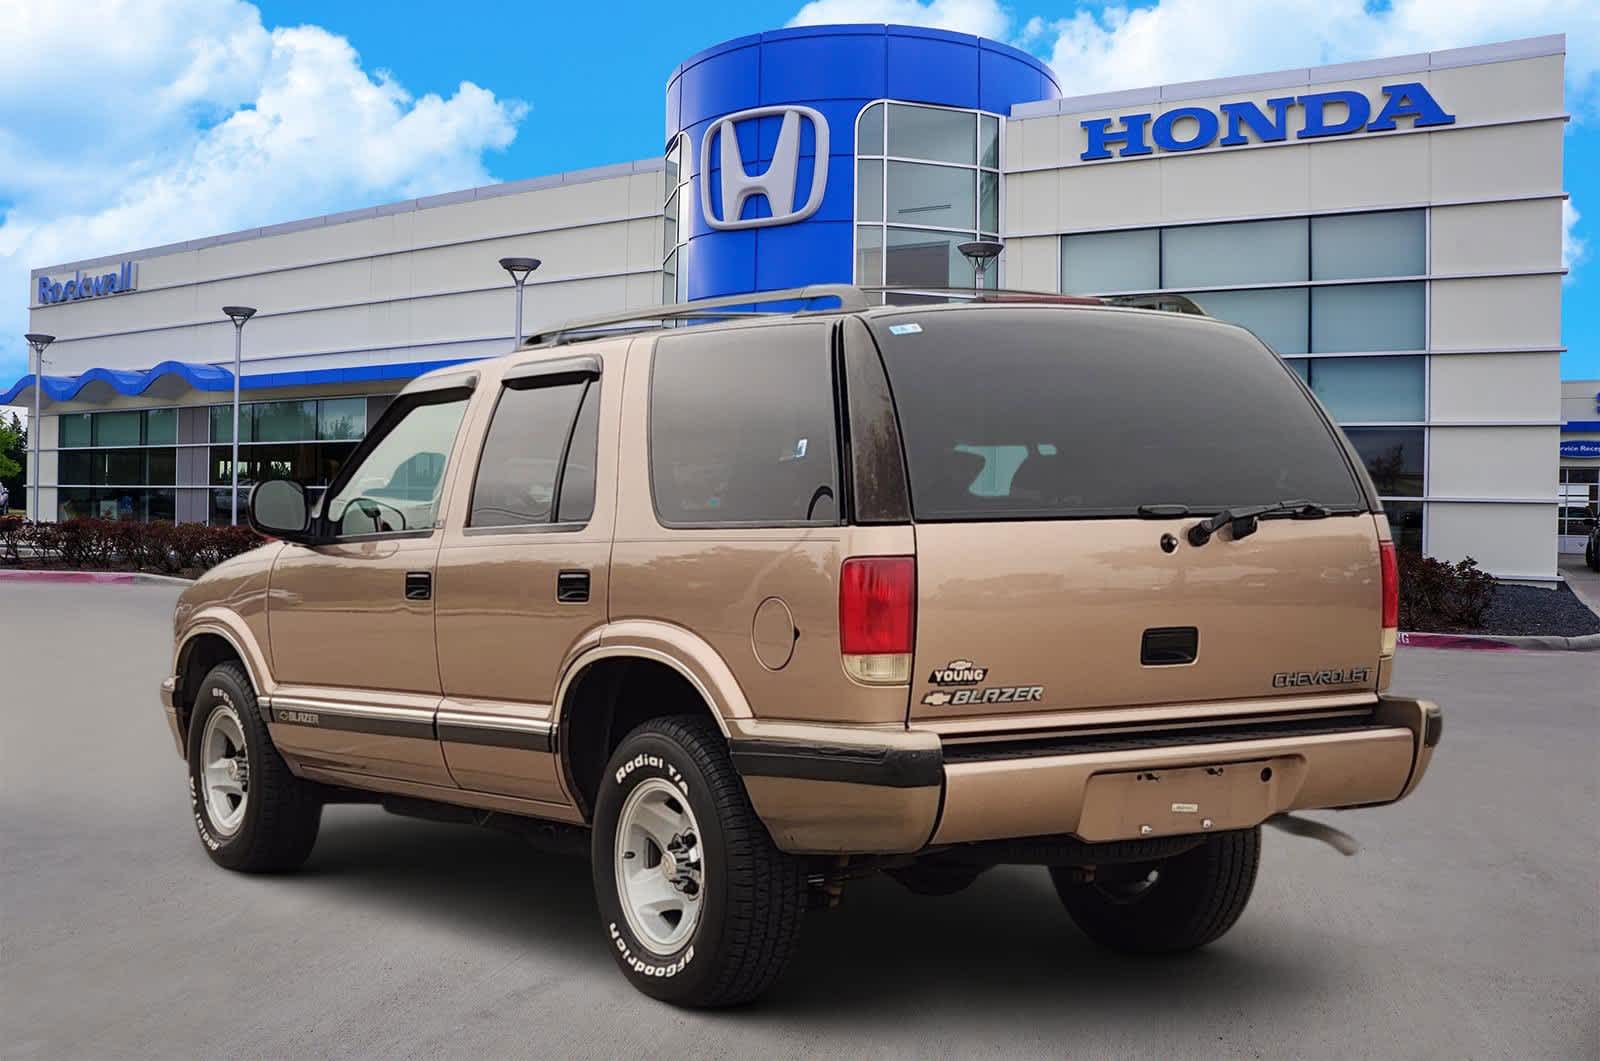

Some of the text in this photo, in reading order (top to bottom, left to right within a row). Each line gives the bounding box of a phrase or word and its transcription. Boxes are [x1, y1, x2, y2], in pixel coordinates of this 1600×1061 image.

[1080, 82, 1456, 161] HONDA
[38, 261, 132, 304] Rockwall
[935, 669, 984, 682] YOUNG
[1272, 666, 1373, 689] CHEVROLET
[950, 686, 1044, 705] BLAZER
[288, 711, 320, 724] BLAZER
[615, 753, 689, 797] Radial T/A
[609, 922, 695, 978] BFGoodrich
